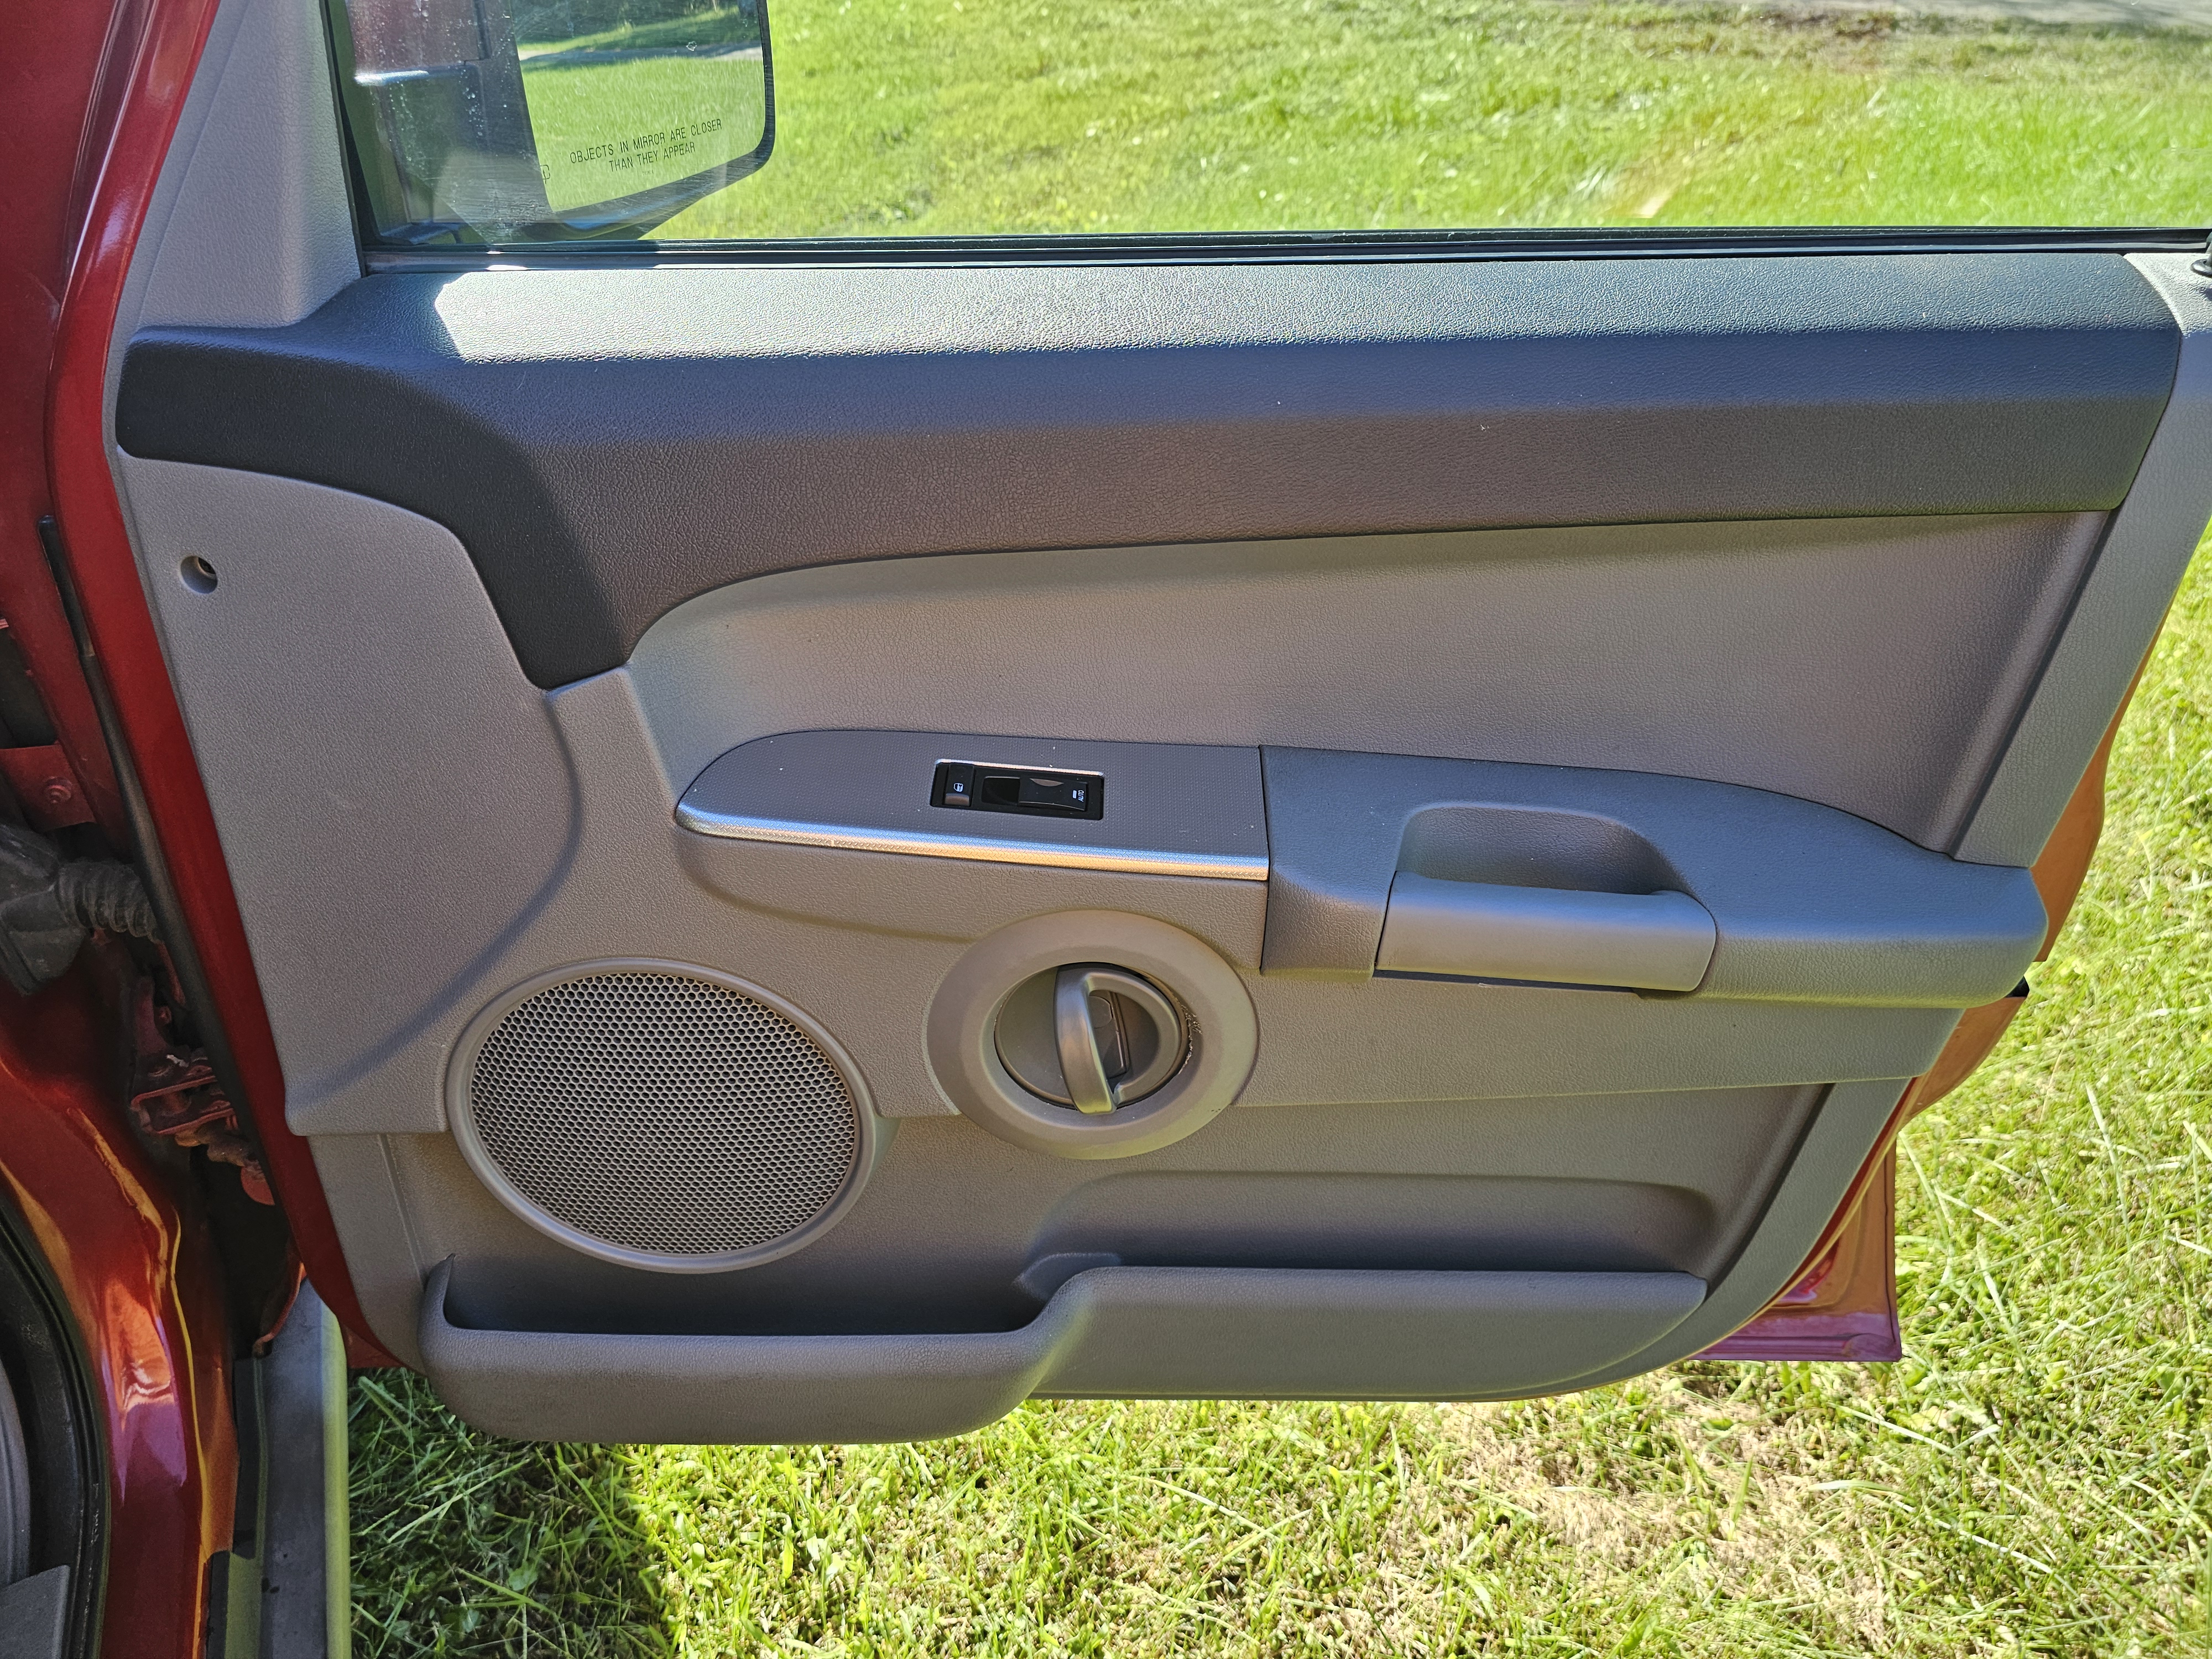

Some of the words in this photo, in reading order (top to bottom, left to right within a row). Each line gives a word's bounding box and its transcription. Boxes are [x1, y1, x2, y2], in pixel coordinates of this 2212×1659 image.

[570, 144, 614, 164] OBJECTS
[619, 140, 629, 153] IN
[633, 132, 665, 150] MIRROR
[670, 127, 686, 142] ARE
[691, 118, 722, 136] CLOSER
[609, 156, 633, 172] THAN
[637, 150, 658, 165] THEY
[664, 142, 695, 160] APPEAR
